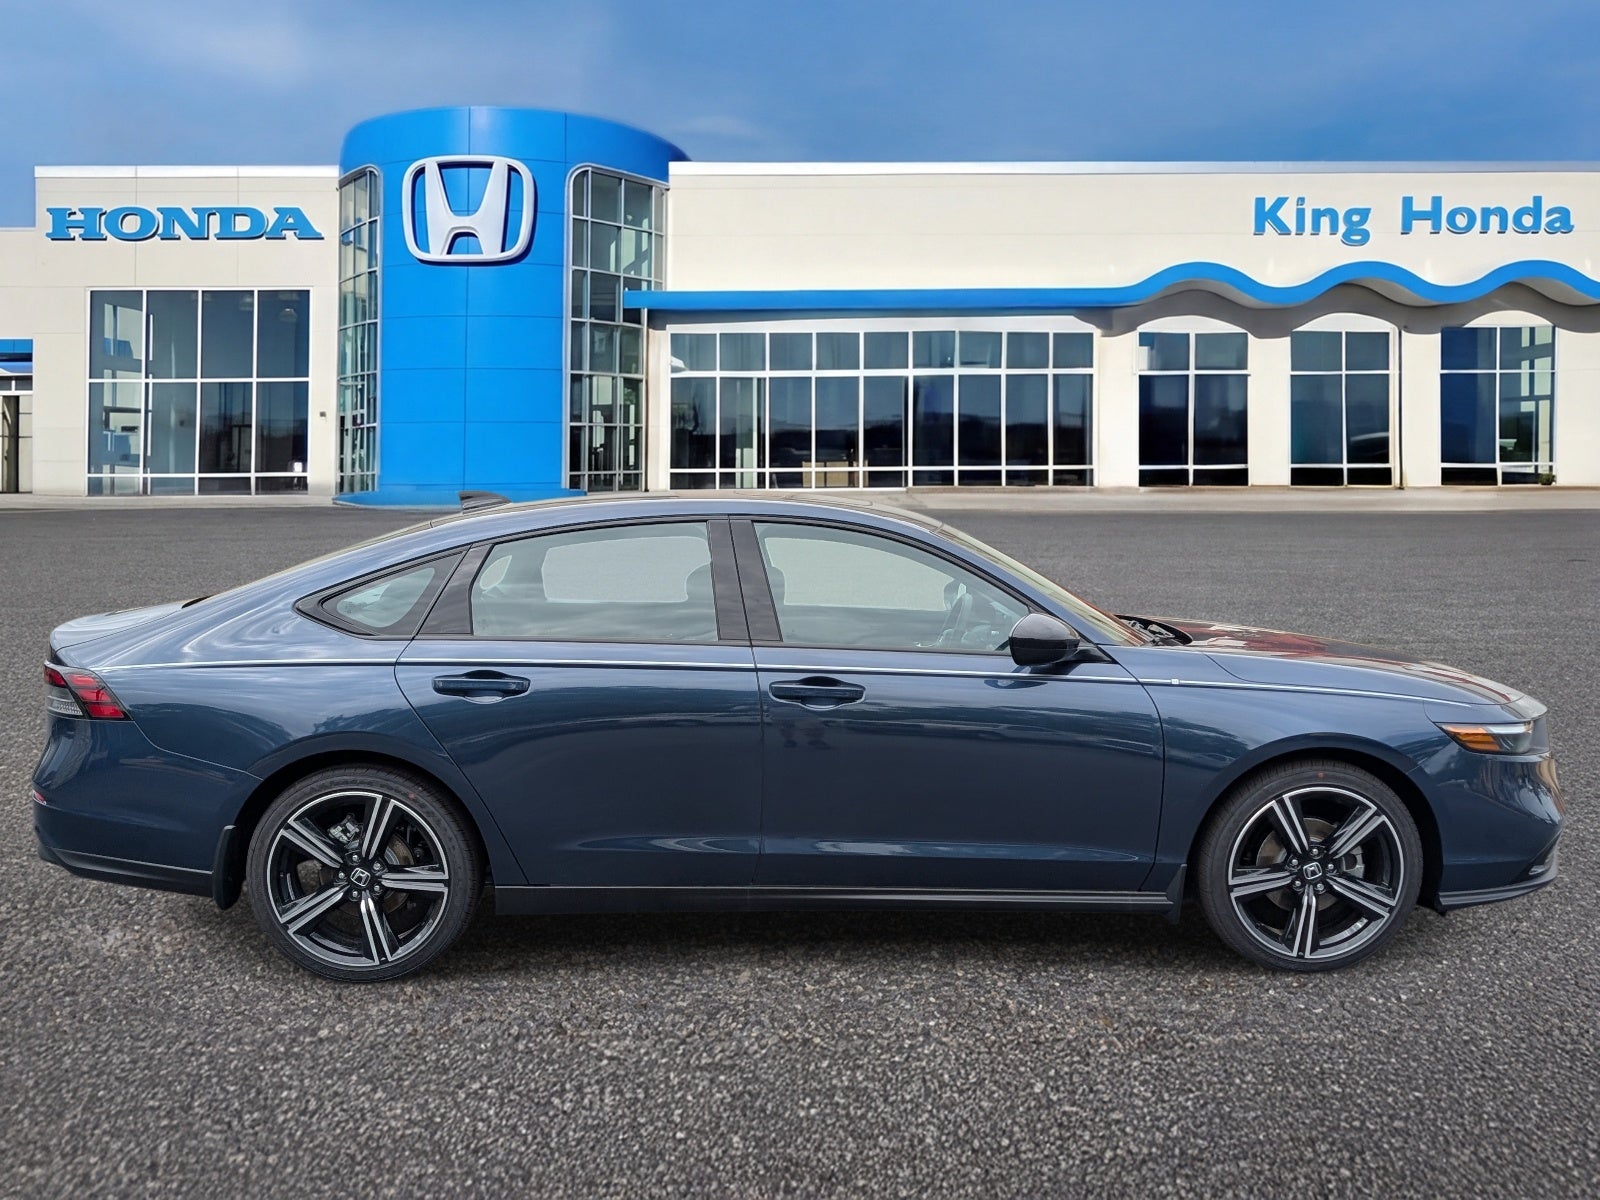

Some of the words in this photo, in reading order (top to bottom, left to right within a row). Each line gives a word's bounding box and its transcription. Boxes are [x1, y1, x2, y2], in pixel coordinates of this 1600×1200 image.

[46, 206, 324, 241] HONDA
[1253, 196, 1372, 246] King
[1401, 195, 1574, 235] Honda
